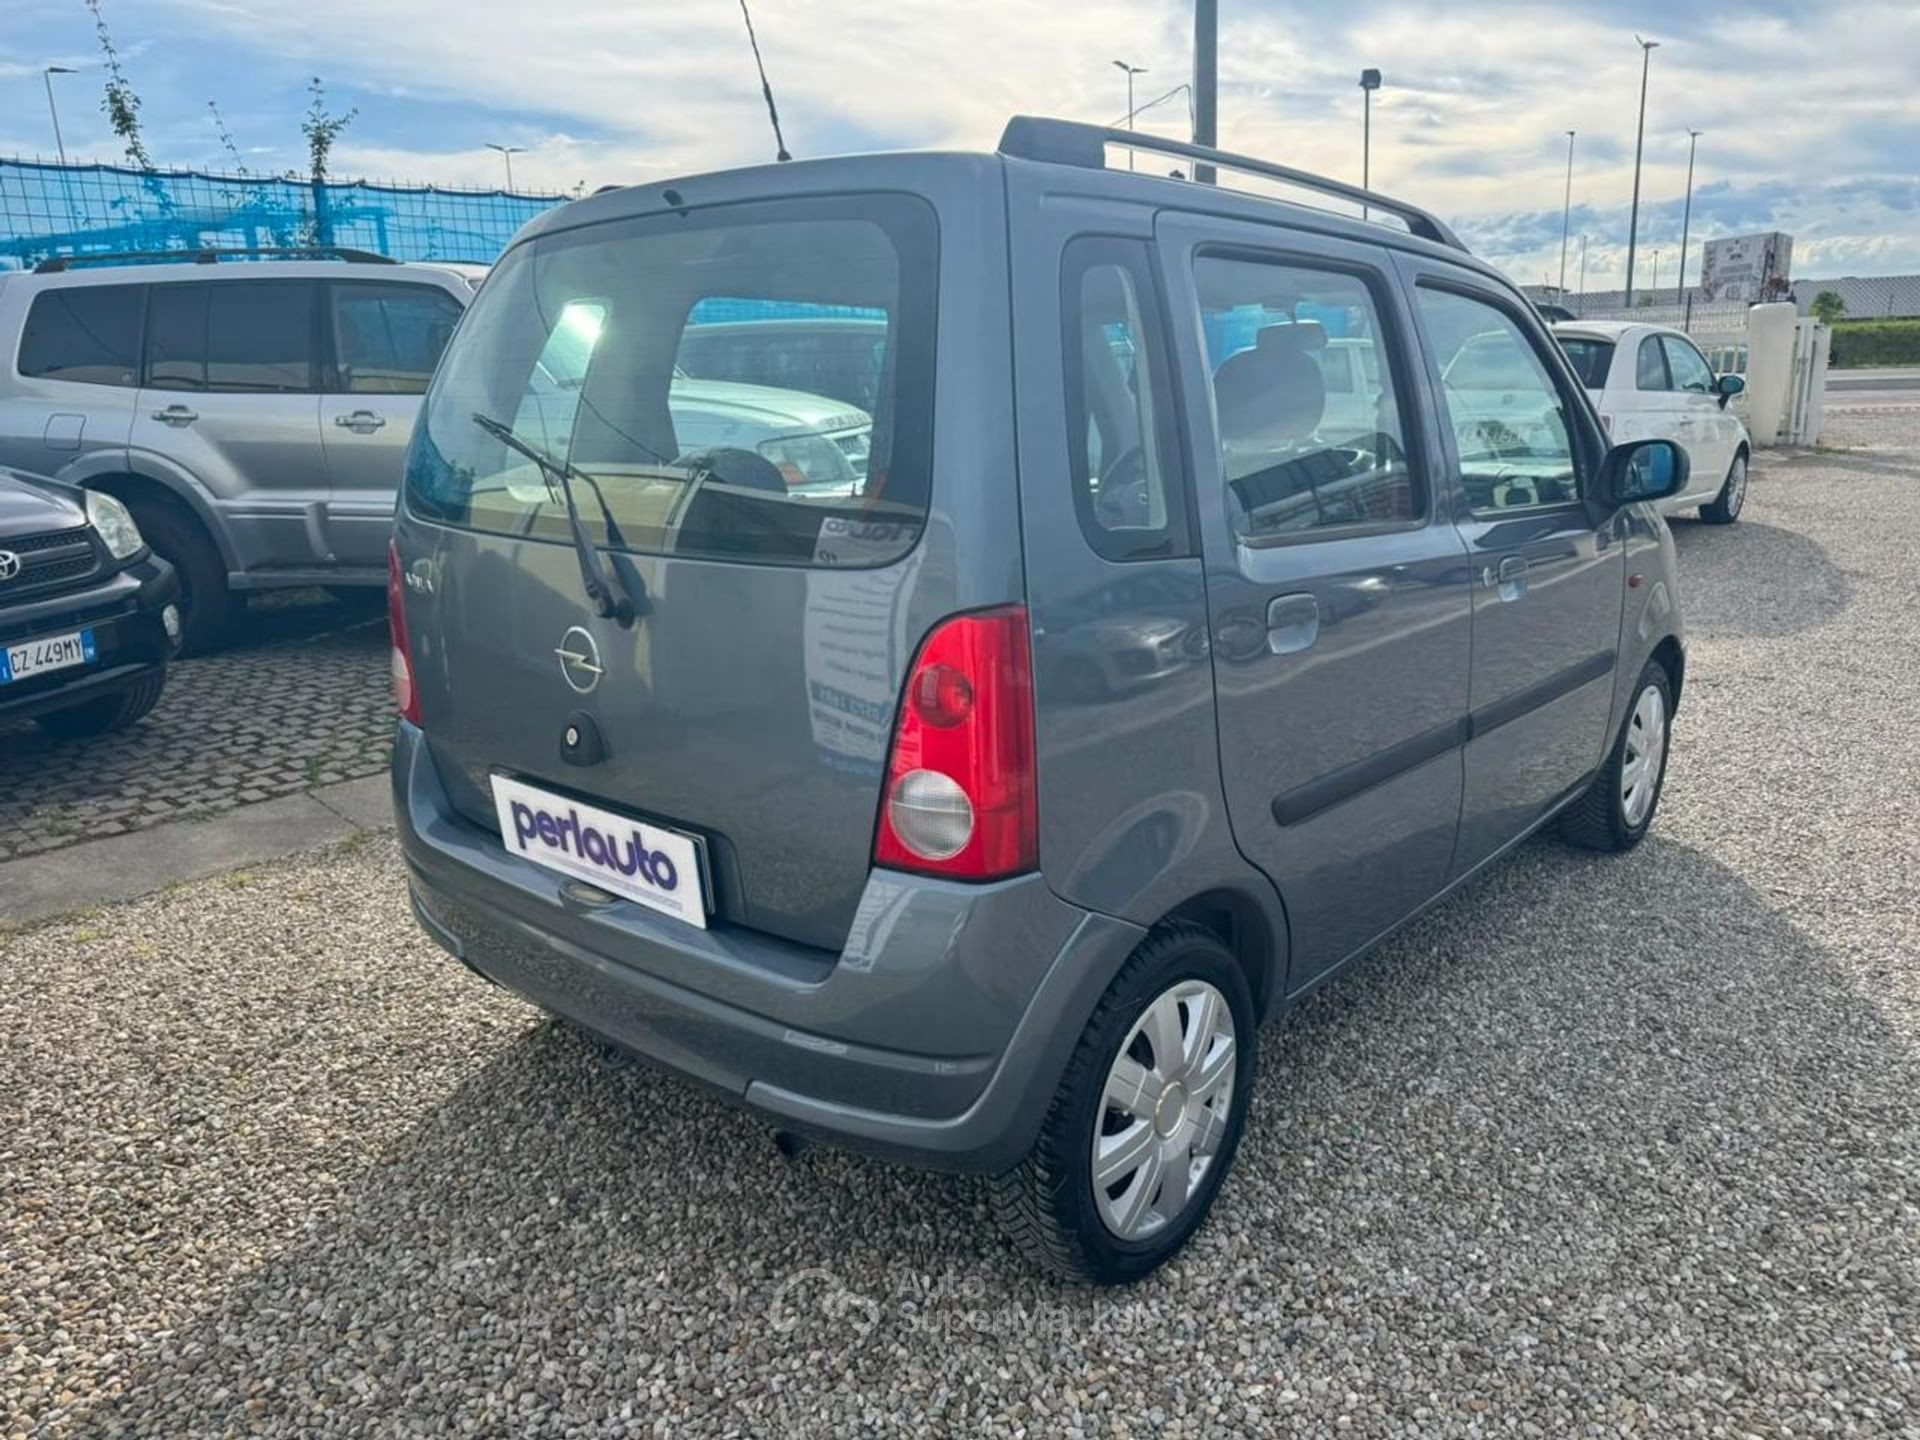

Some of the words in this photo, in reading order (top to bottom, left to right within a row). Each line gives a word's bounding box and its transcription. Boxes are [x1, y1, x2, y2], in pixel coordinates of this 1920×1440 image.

[10, 650, 30, 673] CZ
[35, 638, 81, 666] 449MY
[511, 799, 678, 891] perlauto
